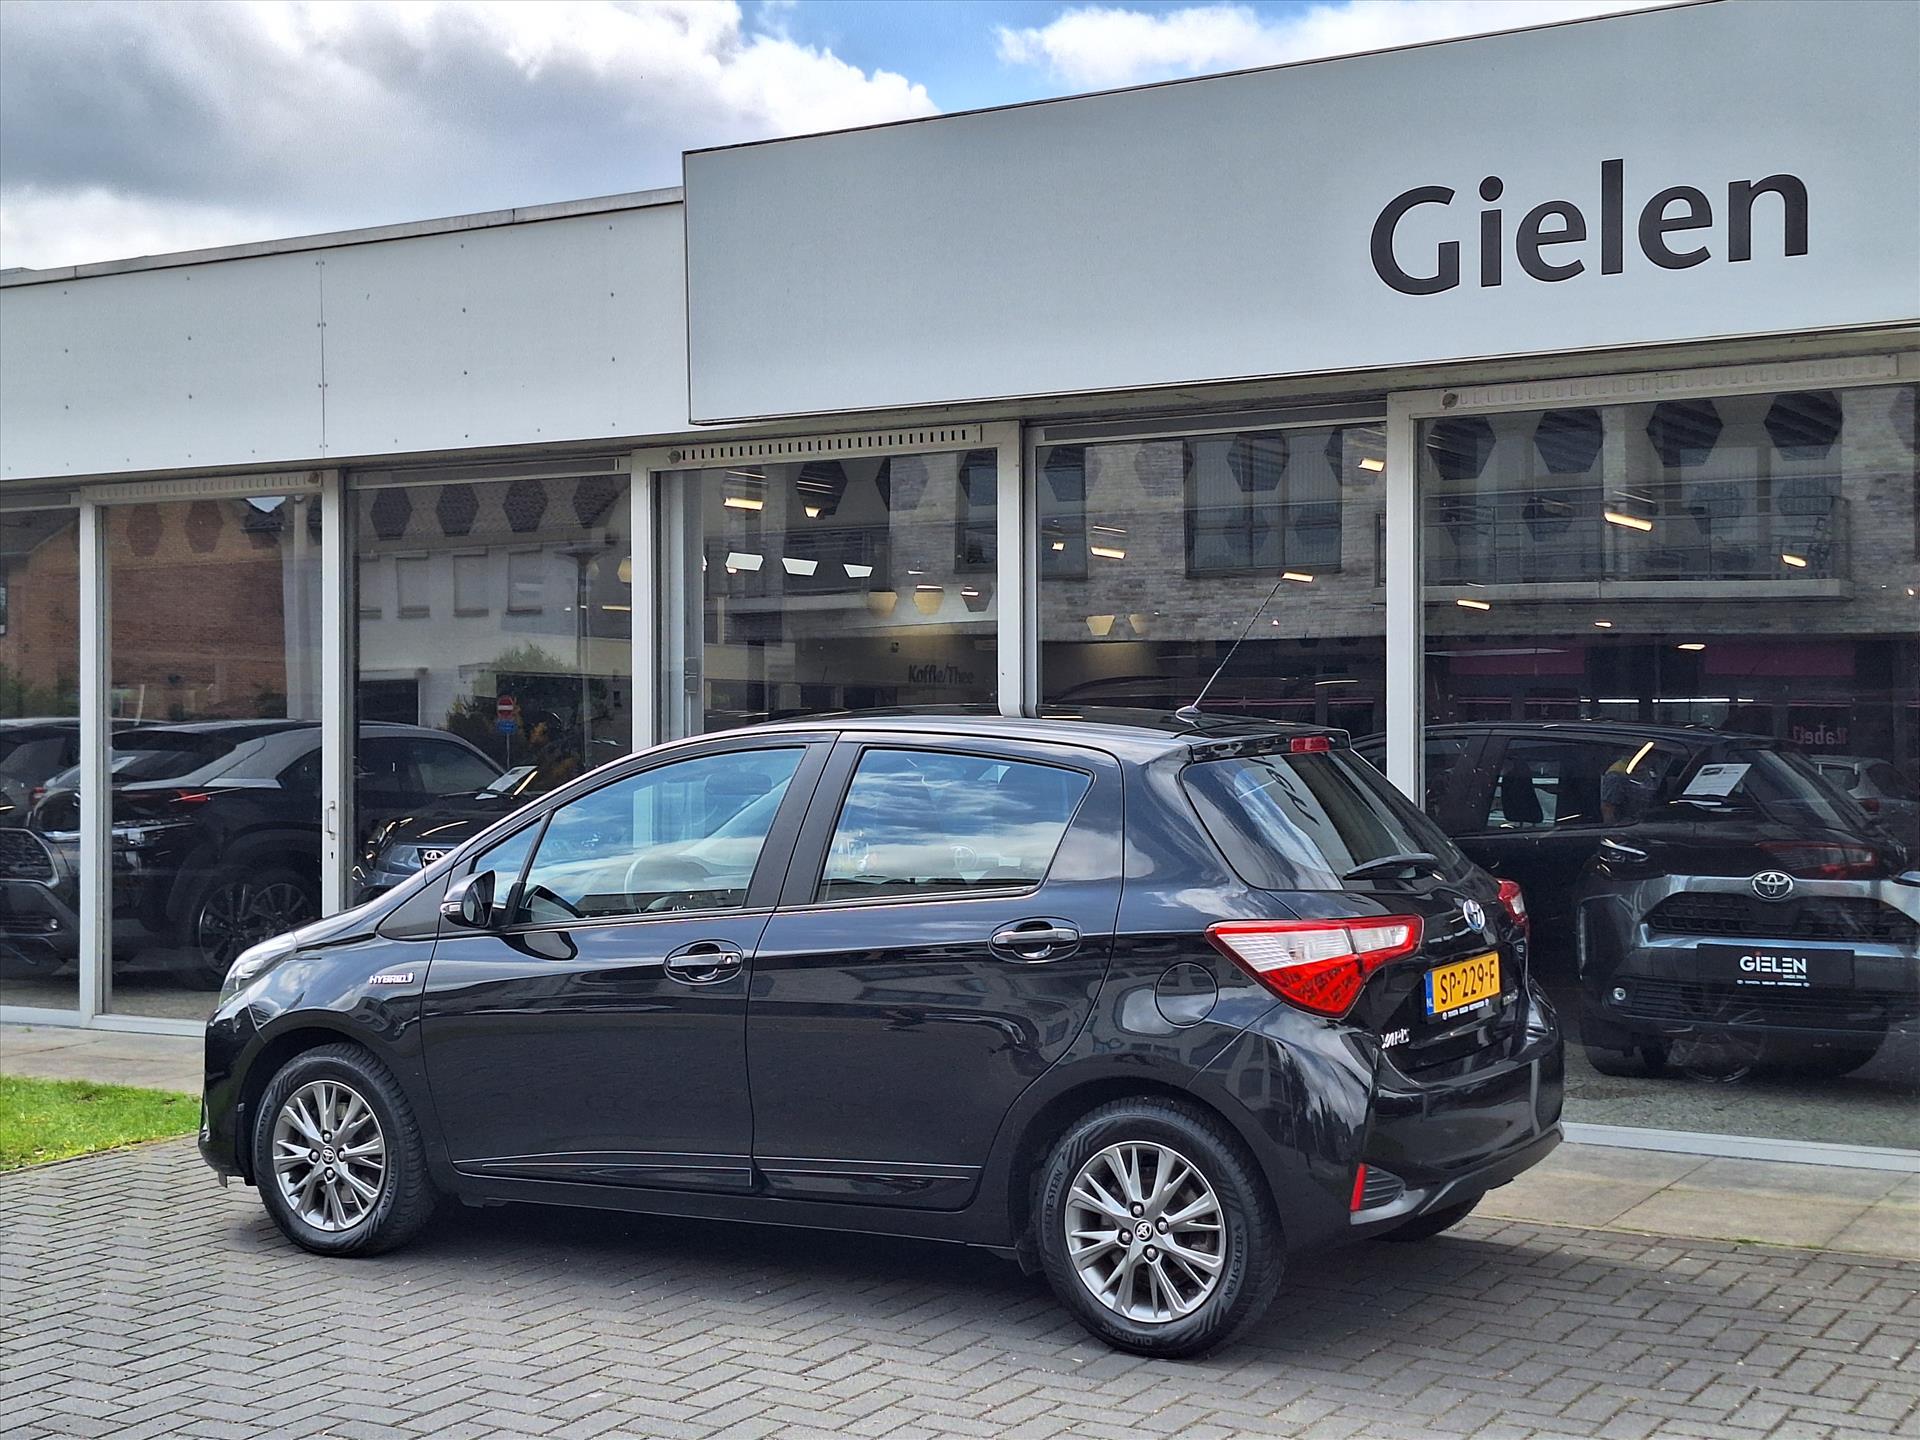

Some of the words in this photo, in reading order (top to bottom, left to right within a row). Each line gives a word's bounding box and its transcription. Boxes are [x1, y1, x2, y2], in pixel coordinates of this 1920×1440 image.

[1370, 159, 1808, 295] Gielen
[369, 973, 407, 984] HYBRID
[1739, 955, 1807, 974] GIELEN
[1440, 960, 1495, 1005] SP-229-F
